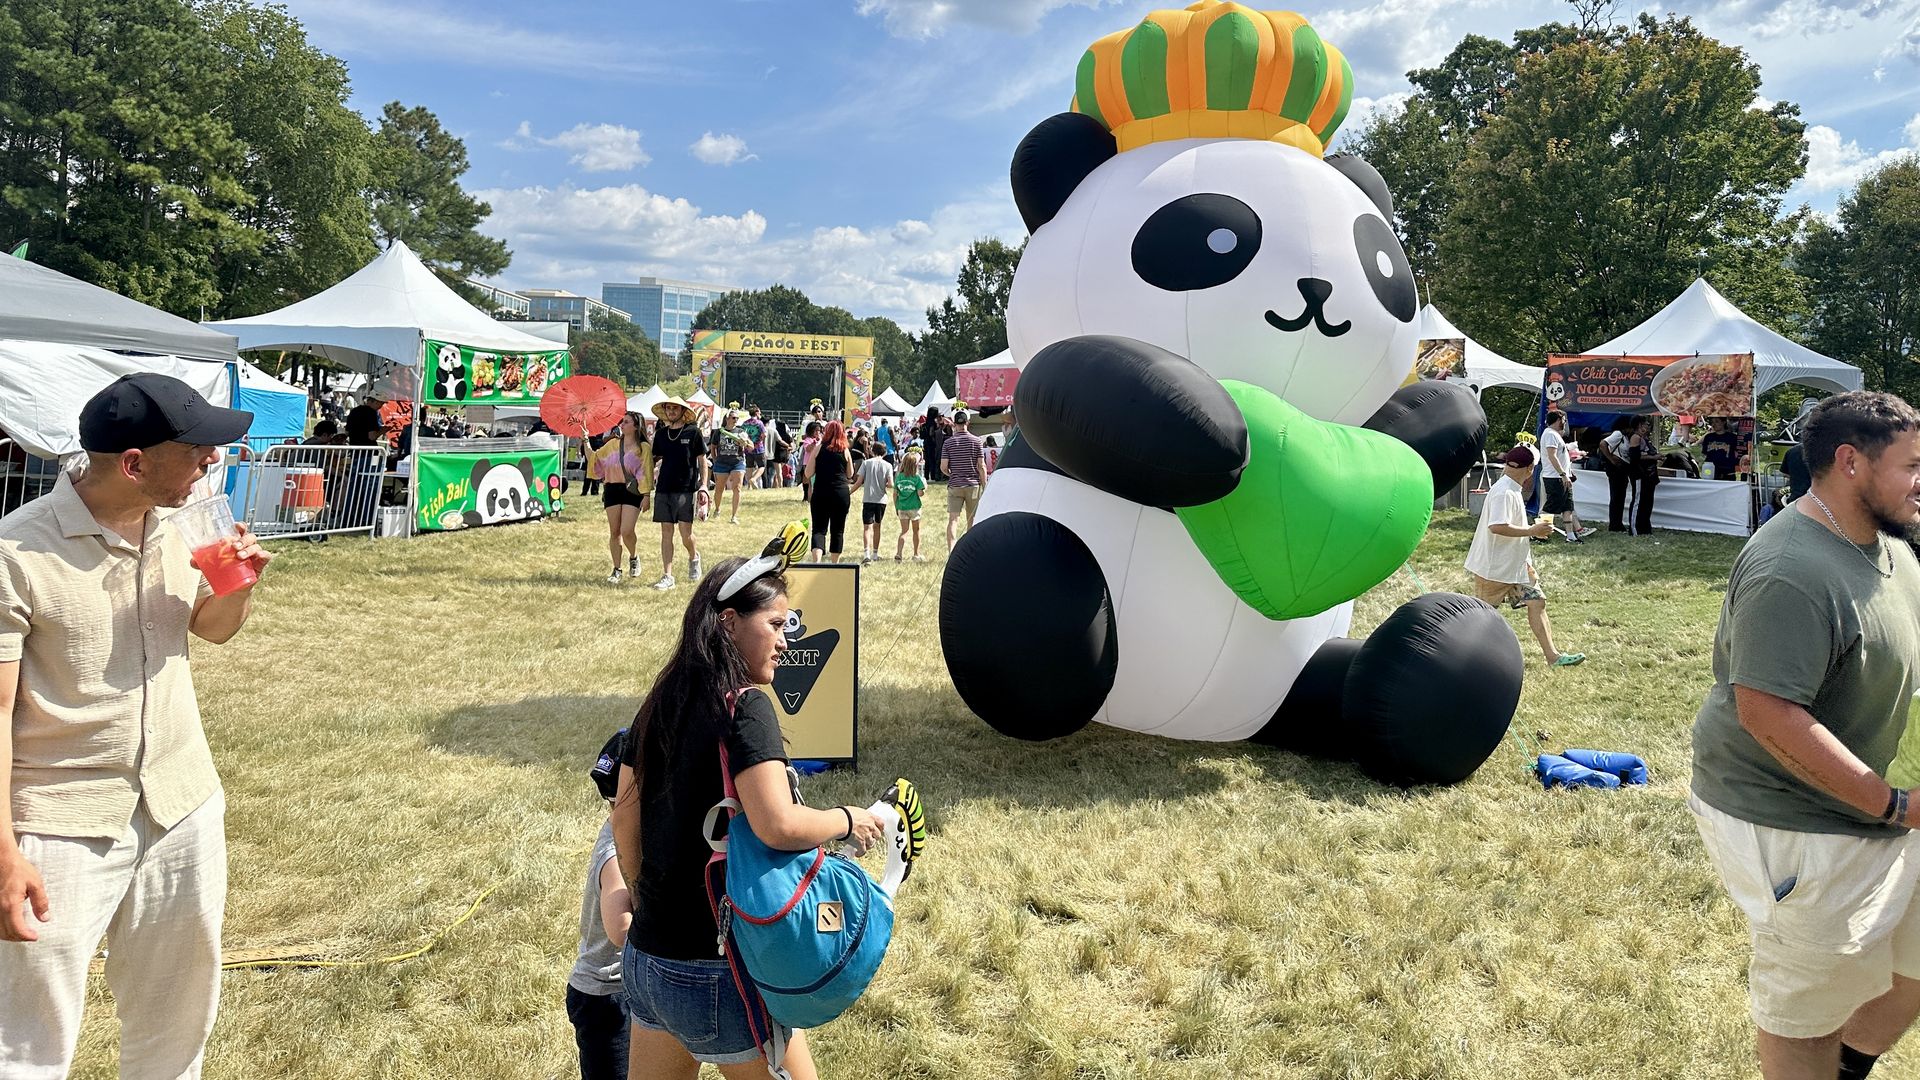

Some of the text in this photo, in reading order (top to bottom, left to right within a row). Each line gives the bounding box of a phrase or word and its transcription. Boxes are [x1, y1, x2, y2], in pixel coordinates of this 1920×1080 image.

[800, 339, 840, 351] FEST
[1580, 367, 1642, 384] Chili Garlic
[1576, 384, 1648, 396] NOODLES
[421, 477, 470, 527] Fish Ball
[777, 649, 820, 666] XIT
